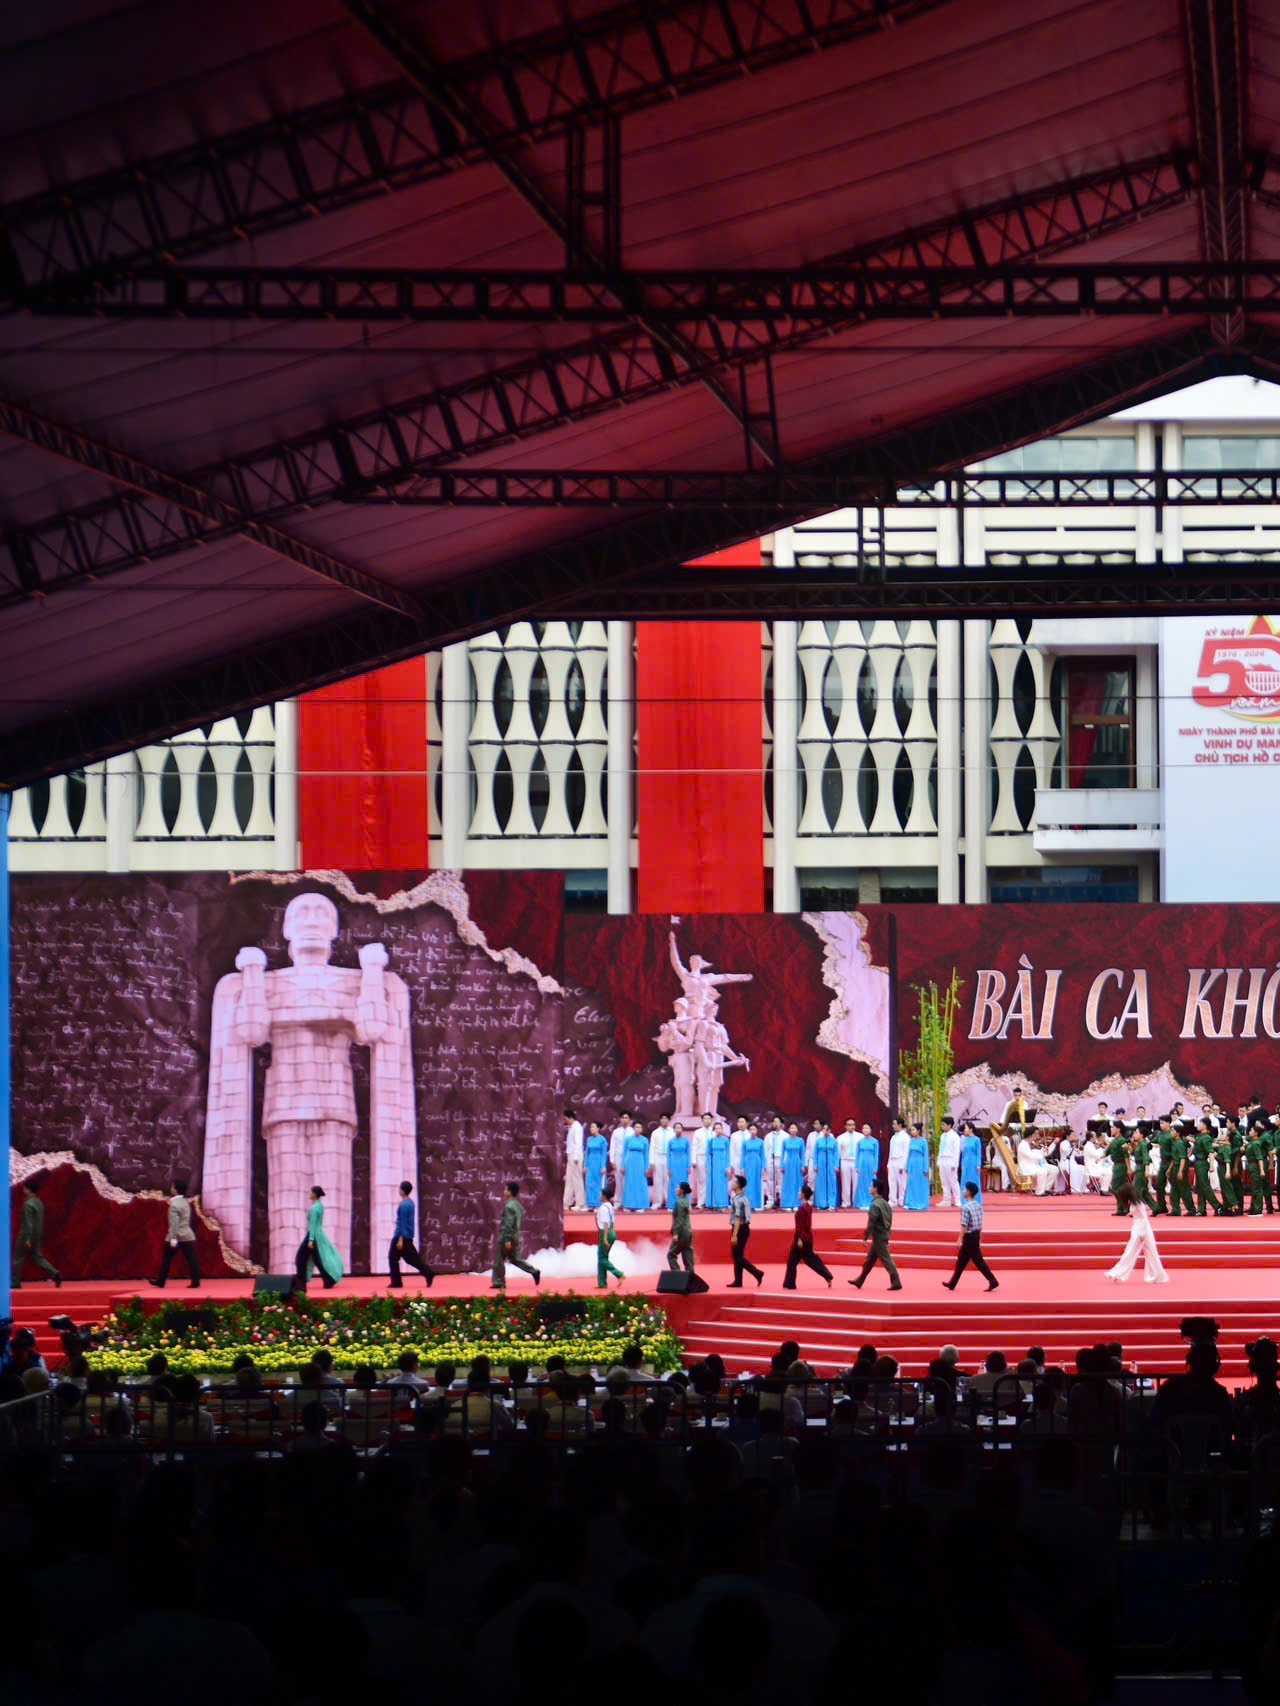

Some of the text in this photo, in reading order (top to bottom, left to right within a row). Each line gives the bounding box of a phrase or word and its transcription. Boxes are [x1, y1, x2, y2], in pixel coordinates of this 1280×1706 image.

[1179, 726, 1203, 736] NGÀY
[1206, 727, 1237, 736] THÀNH
[1203, 739, 1232, 749] VINH
[1223, 753, 1249, 765] TỊCH
[1252, 750, 1270, 763] HỒ
[968, 953, 1064, 1041] BÀI
[1083, 966, 1153, 1041] CA
